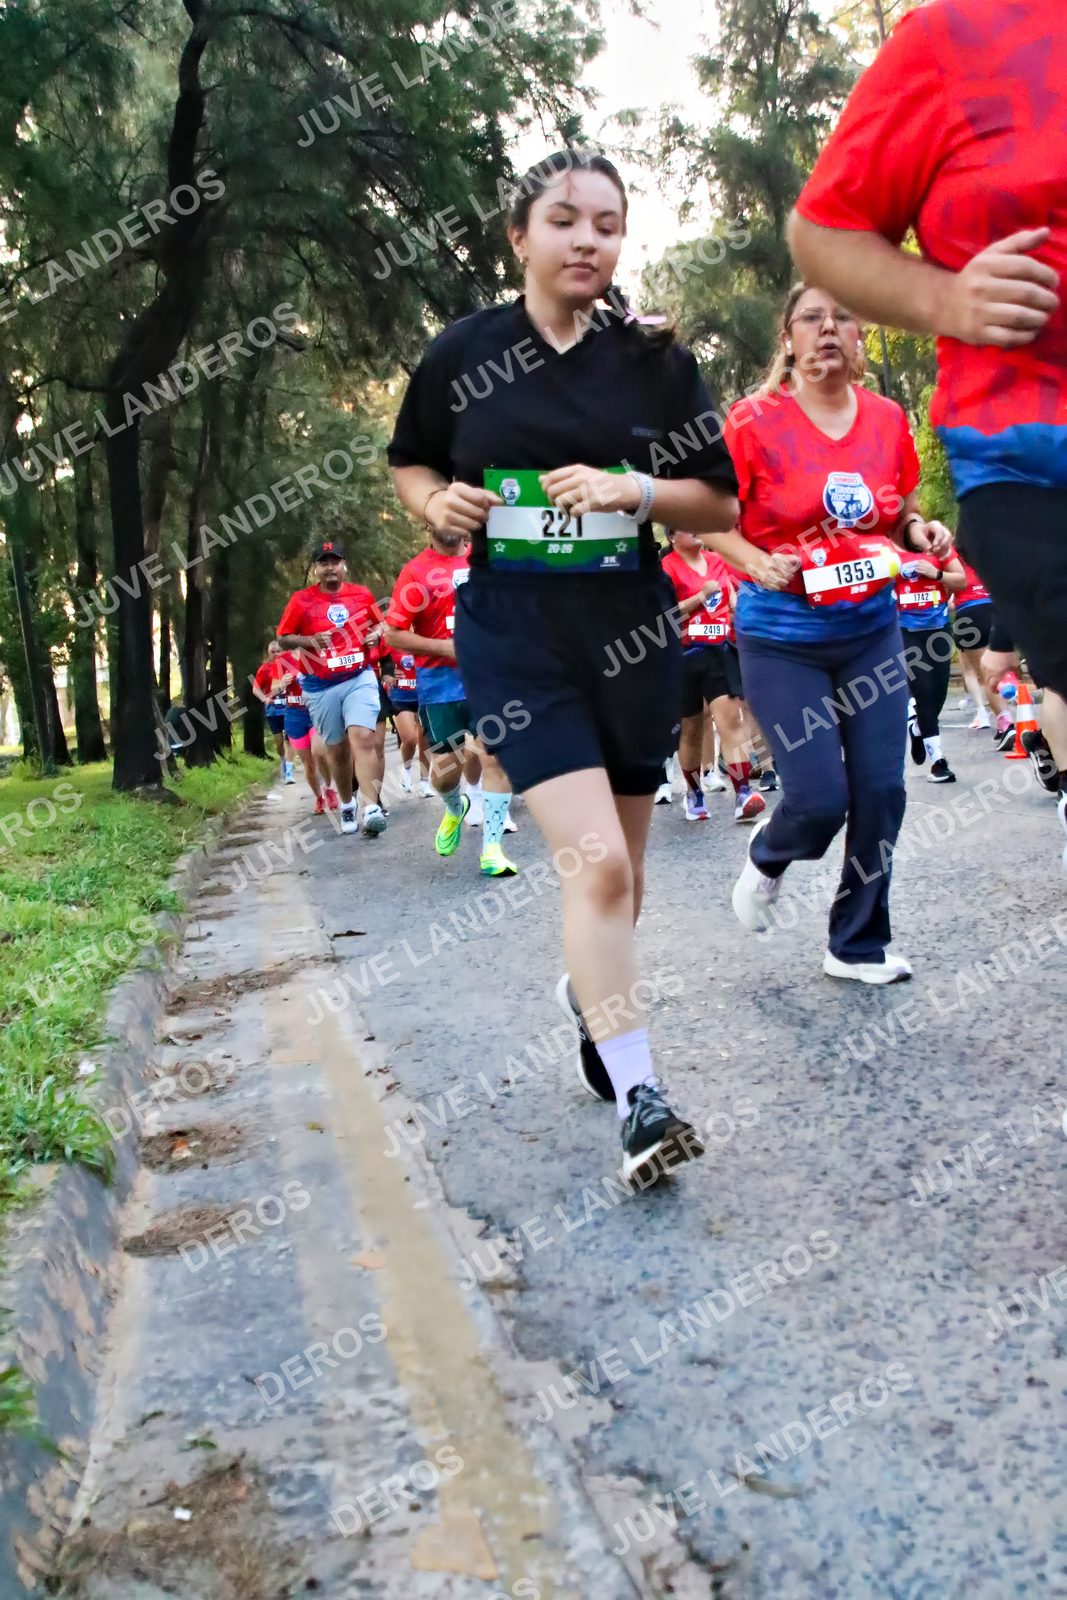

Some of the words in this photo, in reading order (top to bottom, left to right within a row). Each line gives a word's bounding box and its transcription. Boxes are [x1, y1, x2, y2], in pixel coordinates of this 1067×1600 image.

[834, 560, 875, 585] 1353
[913, 592, 929, 602] 1742
[703, 625, 721, 635] 2419
[338, 655, 356, 666] 3368
